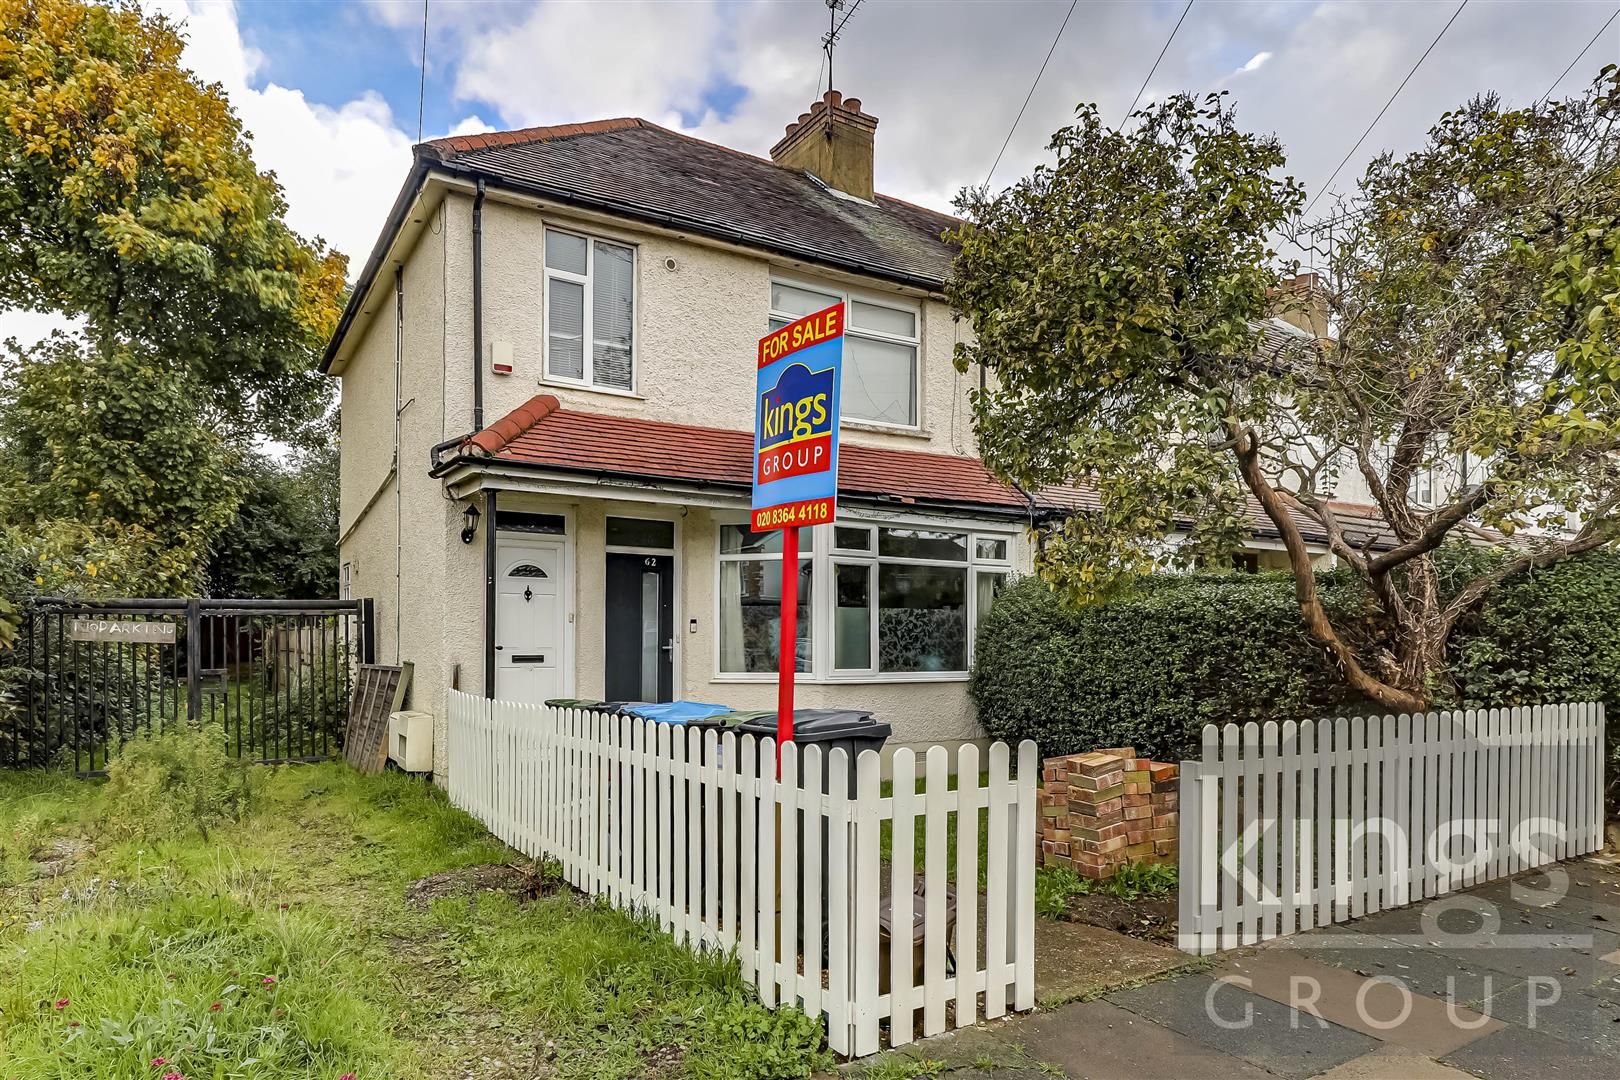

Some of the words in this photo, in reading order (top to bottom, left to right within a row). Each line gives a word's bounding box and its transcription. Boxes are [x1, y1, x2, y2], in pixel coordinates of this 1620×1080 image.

[762, 332, 789, 363] FOR
[793, 311, 838, 347] SALE
[764, 393, 827, 441] kings
[763, 445, 823, 476] GROUP
[756, 511, 771, 527] 020
[773, 506, 796, 524] 8364
[798, 502, 828, 521] 4118
[644, 557, 657, 567] 62
